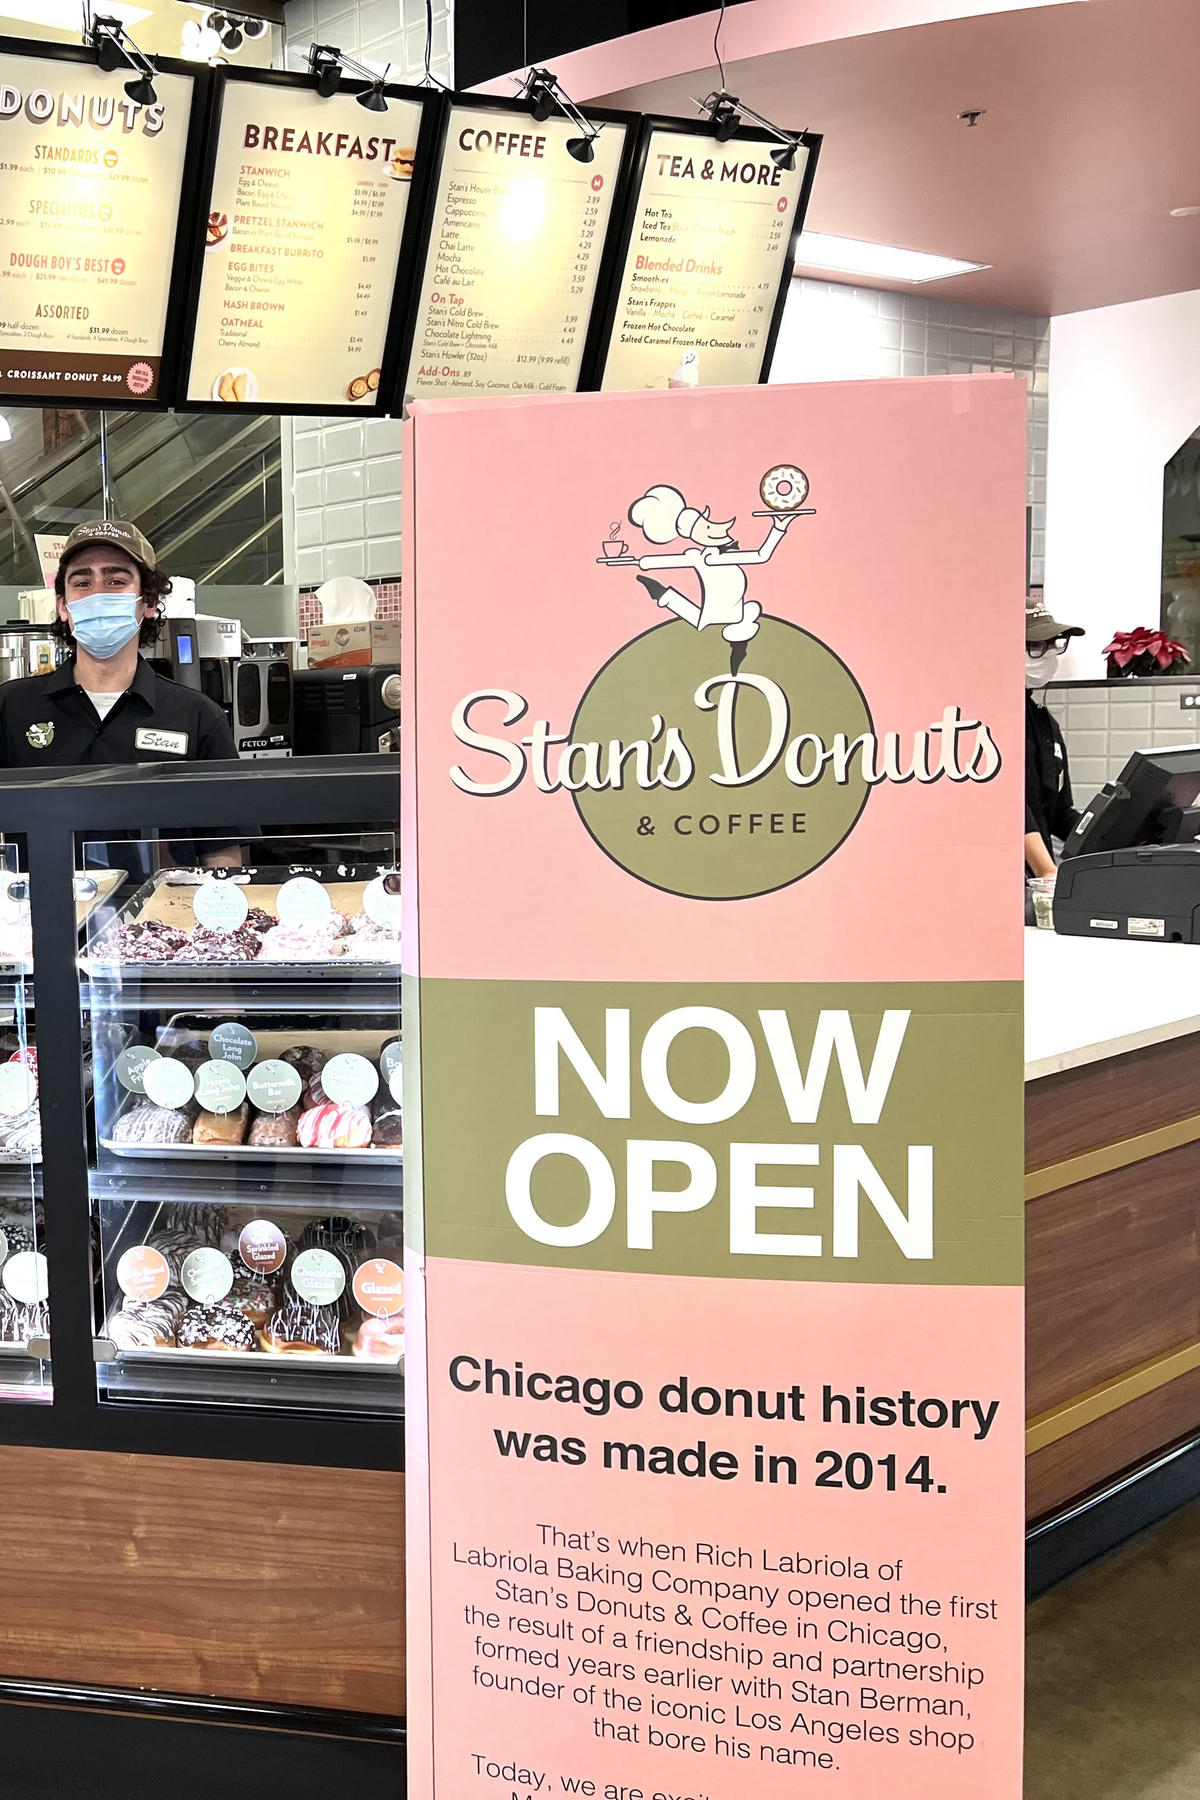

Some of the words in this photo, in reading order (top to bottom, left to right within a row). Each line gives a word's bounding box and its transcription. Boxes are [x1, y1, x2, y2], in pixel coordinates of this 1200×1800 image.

[244, 124, 396, 162] BREAKFAST
[459, 128, 546, 158] COFFEE
[35, 145, 98, 164] STANDARDS
[240, 165, 291, 177] STANWICH
[657, 154, 695, 178] TEA
[701, 159, 714, 180] &
[720, 161, 783, 187] MORE
[447, 193, 476, 205] Espresso
[29, 200, 95, 218] SPECIALTIES
[645, 208, 658, 217] Hot
[661, 210, 672, 218] Tea
[234, 215, 273, 226] PRETZEL
[276, 219, 324, 230] STANWICH
[642, 221, 657, 230] Iced
[660, 222, 671, 231] Tea
[441, 229, 459, 238] Latte
[640, 233, 676, 243] Lemonade
[230, 244, 282, 256] BREAKFAST
[284, 248, 324, 258] BURRITO
[440, 240, 455, 249] Chai
[10, 253, 47, 268] DOUGH
[51, 256, 81, 270] BOY'S
[85, 258, 110, 272] BEST
[438, 253, 461, 262] Mocha
[228, 262, 247, 272] EGG
[249, 264, 274, 273] BITES
[435, 264, 449, 274] Hot
[635, 255, 684, 272] Blended
[686, 259, 722, 275] Drinks
[632, 273, 669, 284] Smoothies
[224, 300, 248, 309] HASH
[250, 301, 285, 311] BROWN
[431, 293, 446, 304] On
[449, 294, 464, 306] Tap
[35, 304, 90, 320] ASSORTED
[428, 306, 447, 316] Stan's
[450, 307, 466, 317] Cold
[467, 308, 483, 317] Brew
[221, 318, 264, 328] OATMEAL
[426, 317, 445, 327] Stan's
[447, 318, 464, 328] Nitro
[466, 320, 482, 329] Cold
[484, 321, 499, 329] Brew
[623, 321, 646, 330] Frozen
[648, 323, 661, 331] Hot
[663, 324, 695, 333] Chocolate
[425, 329, 459, 339] Chocolate
[461, 331, 491, 341] Lightning
[621, 334, 642, 344] Salted
[644, 336, 671, 345] Caramel
[672, 337, 694, 346] Frozen
[695, 338, 708, 347] Hot
[709, 339, 741, 349] Chocolate
[219, 339, 237, 349] Cherry
[442, 351, 465, 360] Howler
[7, 370, 60, 380] CROISSANT
[65, 372, 98, 381] DONUT
[102, 374, 122, 382] $4.99
[418, 366, 460, 378] Add-Ons
[142, 733, 179, 748] Stan
[449, 689, 696, 798] Stan's
[694, 672, 1002, 788] Donuts
[637, 816, 656, 836] &
[674, 812, 808, 835] COFFEE
[214, 1034, 252, 1047] Chocolate
[222, 1044, 242, 1055] Long
[222, 1052, 241, 1061] John
[534, 1006, 911, 1124] NOW
[505, 1133, 934, 1260] OPEN
[252, 1252, 275, 1260] Glazed
[361, 1282, 402, 1294] Glazed
[449, 1355, 643, 1415] Chicago
[659, 1376, 805, 1421] donut
[822, 1385, 1000, 1439] history
[494, 1429, 586, 1465] was
[604, 1439, 738, 1480] made
[755, 1445, 798, 1484] in
[815, 1451, 947, 1494] 2014.
[537, 1524, 609, 1552] That's
[618, 1537, 685, 1562] when
[696, 1543, 752, 1569] Rich
[763, 1549, 869, 1579] Labriola
[878, 1560, 903, 1581] of
[453, 1542, 548, 1575] Labriola
[557, 1557, 642, 1593] Baking
[652, 1570, 779, 1608] Company
[788, 1589, 890, 1613] opened
[900, 1593, 941, 1616] the
[950, 1596, 997, 1619] first
[496, 1579, 568, 1609] Stan's
[577, 1591, 665, 1622] Donuts
[674, 1605, 692, 1625] &
[702, 1607, 787, 1636] Coffee
[797, 1617, 817, 1639] in
[828, 1620, 947, 1653] Chicago,
[464, 1605, 500, 1628] the
[509, 1615, 573, 1641] result
[582, 1625, 604, 1644] of
[613, 1632, 627, 1648] a
[636, 1630, 763, 1669] friendship
[772, 1652, 821, 1671] and
[833, 1658, 984, 1689] partnership
[475, 1636, 558, 1668] formed
[568, 1656, 635, 1680] years
[644, 1668, 722, 1692] earlier
[731, 1677, 782, 1699] with
[792, 1681, 849, 1707] Stan
[860, 1688, 971, 1720] Berman,
[473, 1665, 564, 1699] founder
[573, 1686, 595, 1704] of
[604, 1689, 642, 1712] the
[651, 1695, 725, 1723] iconic
[736, 1705, 781, 1730] Los
[791, 1713, 899, 1743] Angeles
[909, 1725, 974, 1754] shop
[593, 1718, 639, 1743] that
[648, 1725, 705, 1752] bore
[715, 1734, 750, 1759] his
[760, 1745, 840, 1770] name.
[471, 1754, 551, 1791] Today,
[561, 1777, 595, 1796] we
[605, 1784, 643, 1800] are
